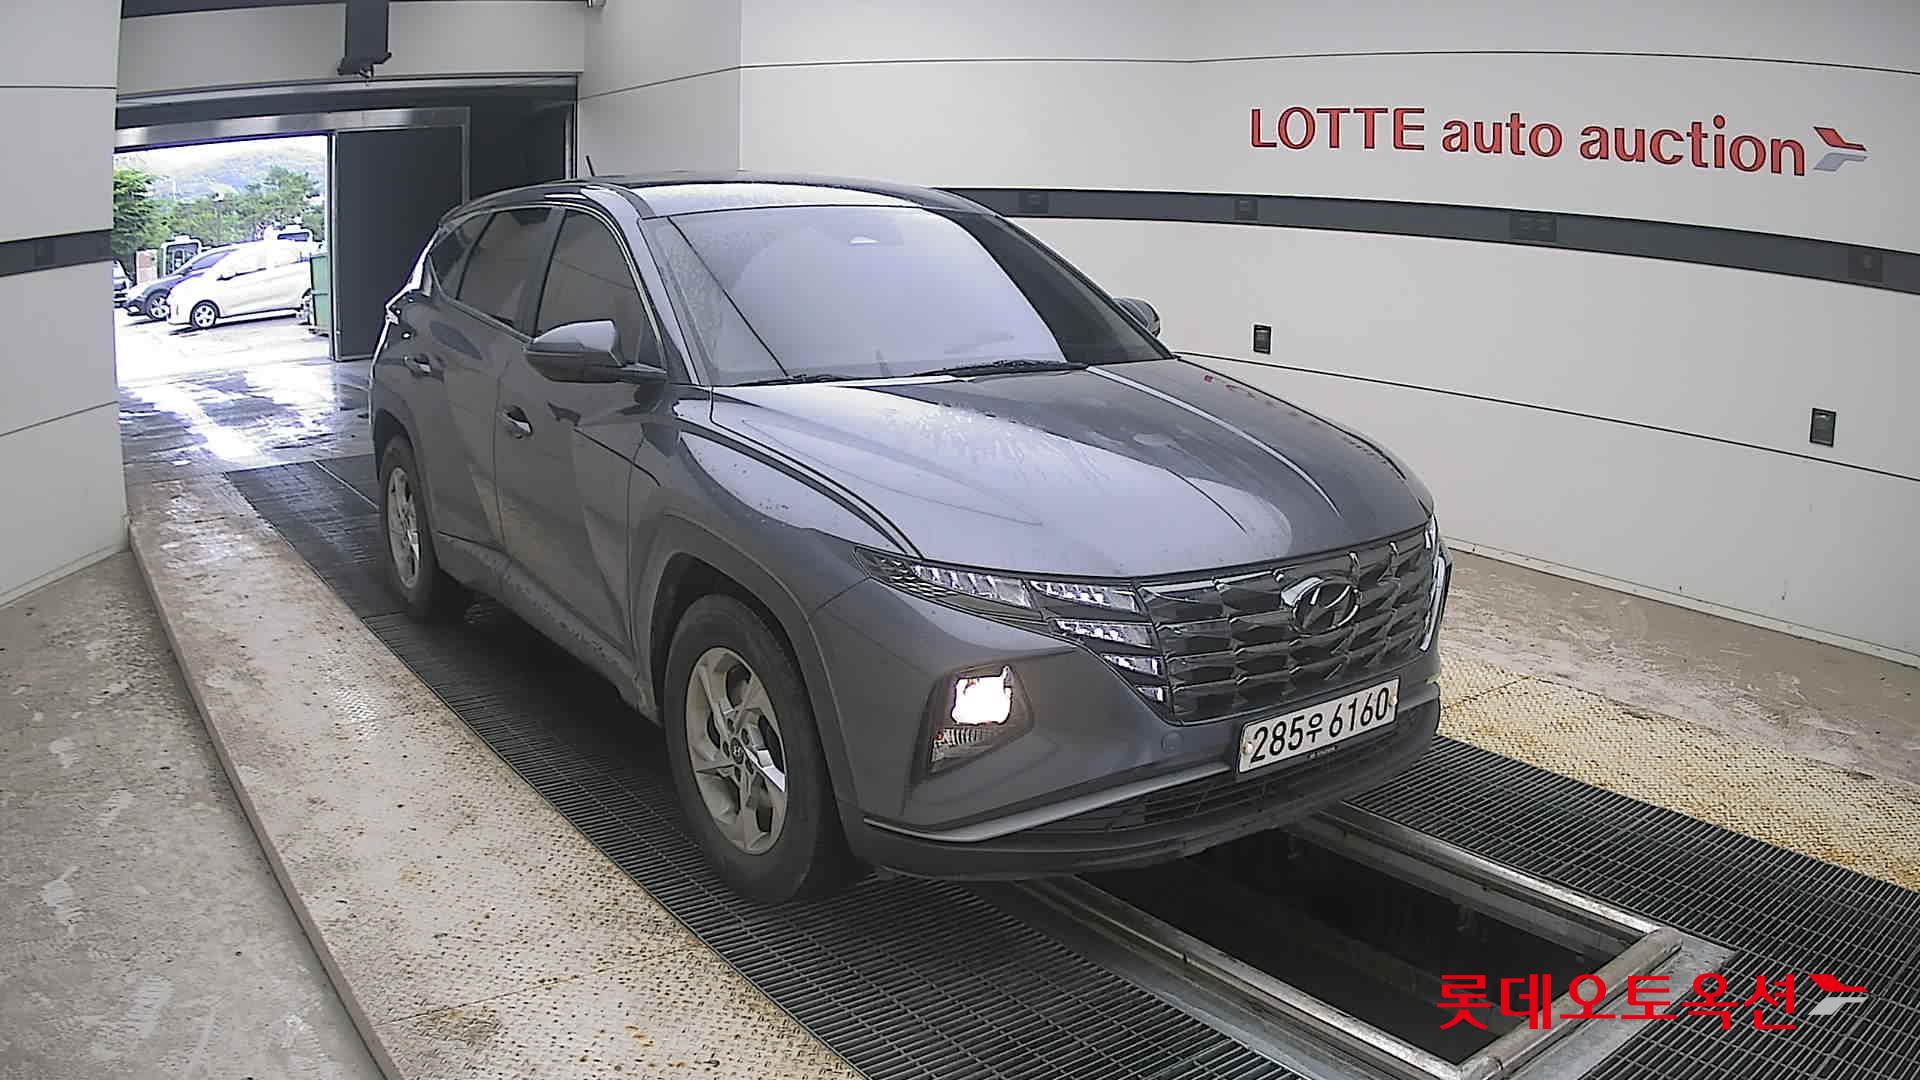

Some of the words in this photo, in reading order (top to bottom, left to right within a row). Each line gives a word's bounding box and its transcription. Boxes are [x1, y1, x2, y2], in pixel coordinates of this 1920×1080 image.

[1250, 107, 1425, 150] LOTTE
[1442, 112, 1562, 158] auto
[1579, 115, 1806, 177] auction
[1250, 713, 1323, 763] 285우
[1329, 687, 1389, 738] 6160
